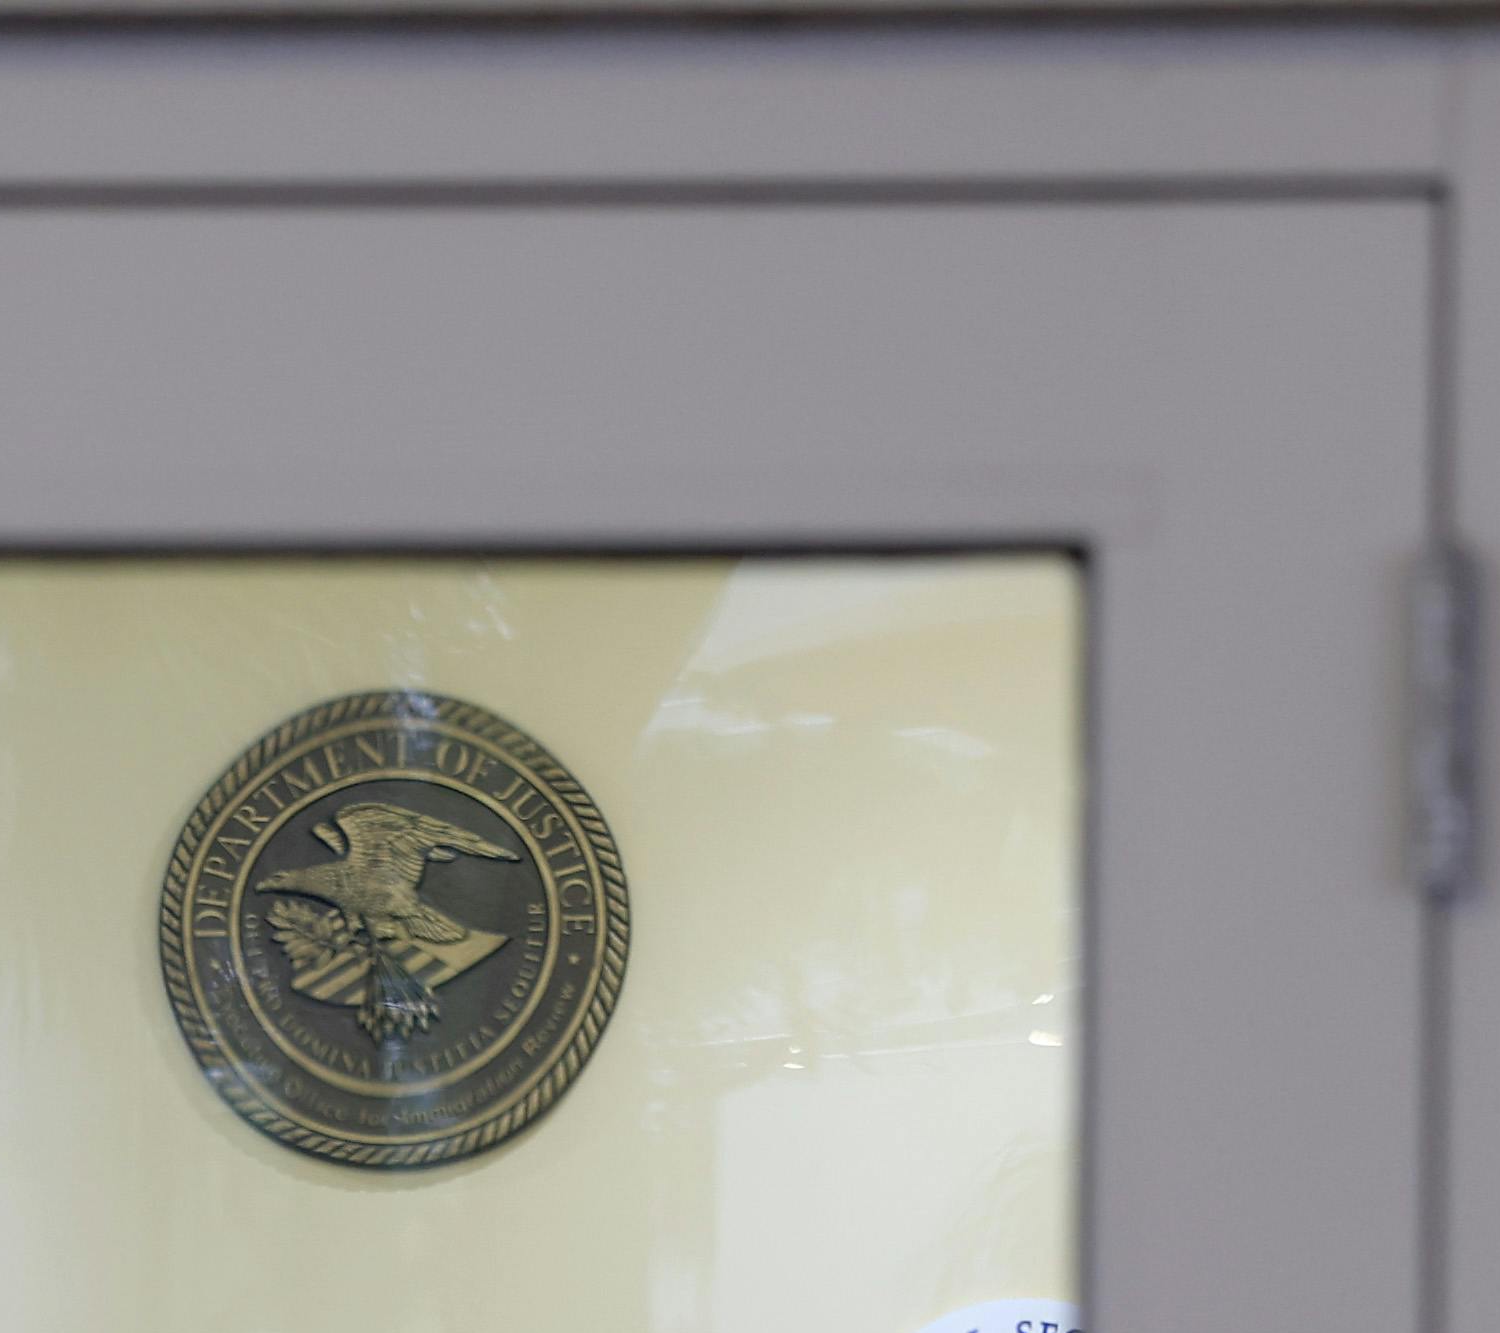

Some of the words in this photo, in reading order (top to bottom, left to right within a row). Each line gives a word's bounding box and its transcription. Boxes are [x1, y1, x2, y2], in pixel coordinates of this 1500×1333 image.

[193, 730, 412, 938] DEPARTMENT
[436, 738, 498, 785] OF
[493, 776, 596, 937] JUSTICE
